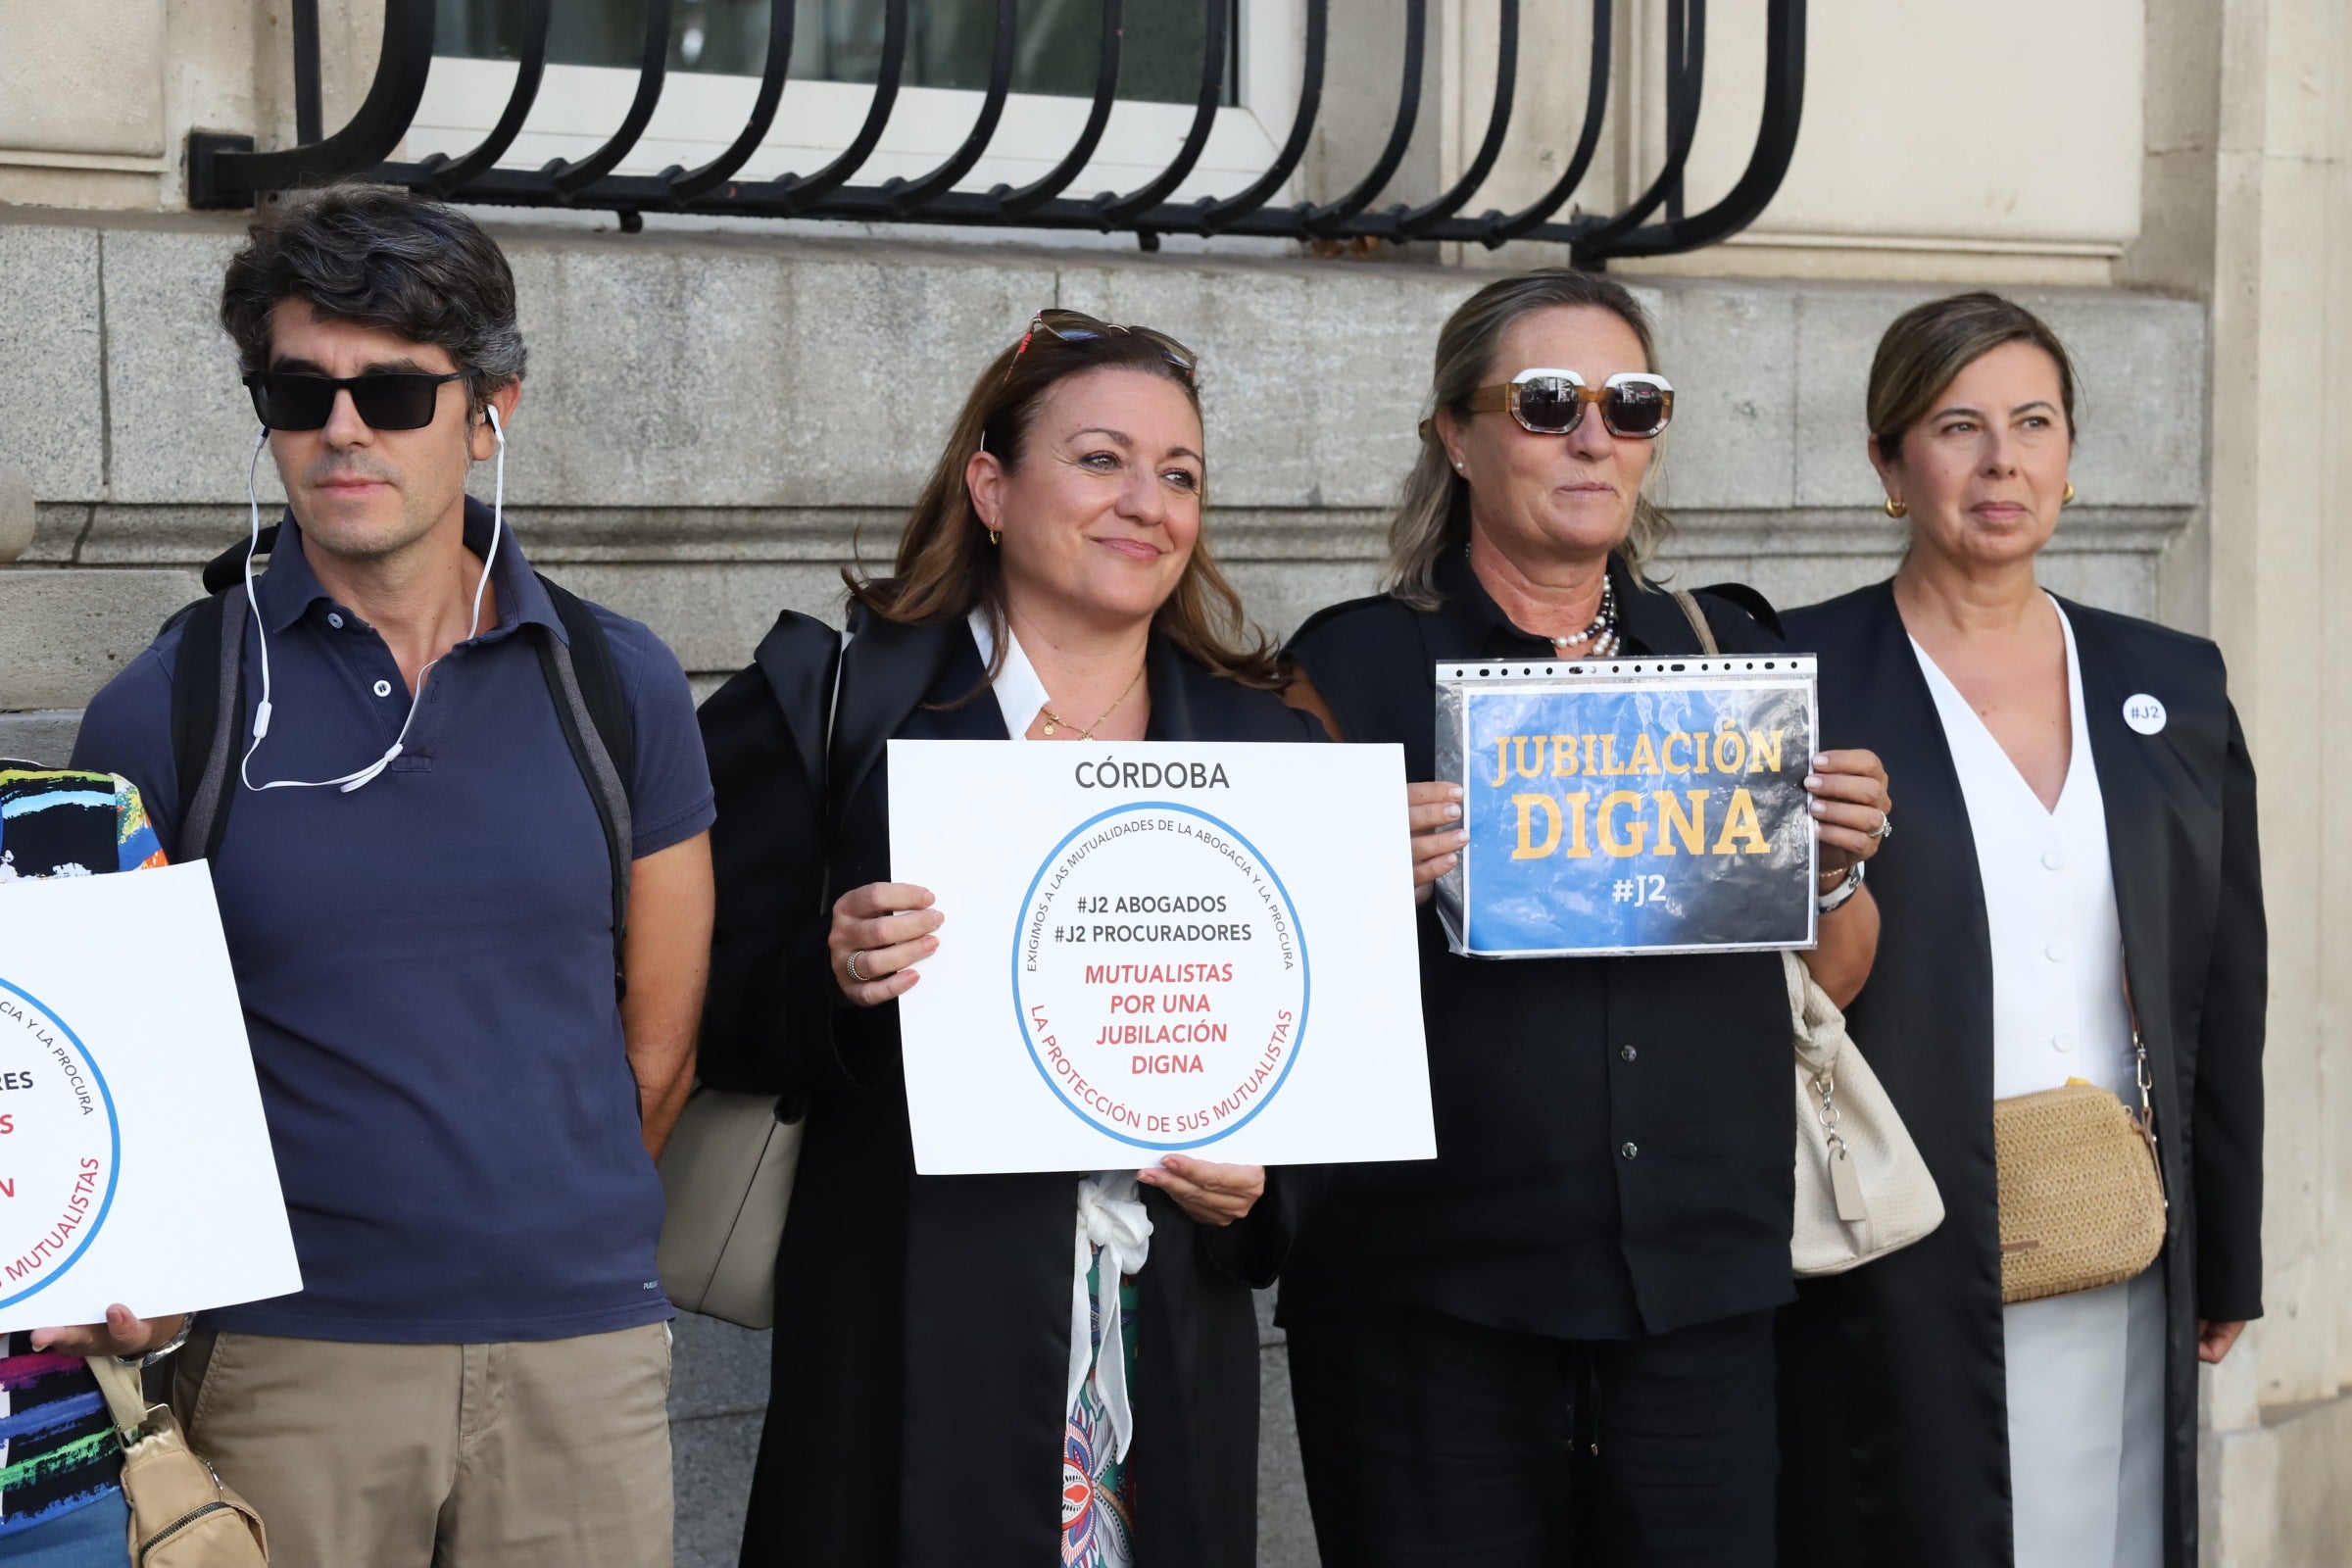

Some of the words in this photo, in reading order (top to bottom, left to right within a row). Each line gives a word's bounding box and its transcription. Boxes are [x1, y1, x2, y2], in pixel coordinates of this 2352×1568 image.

[2131, 706, 2160, 719] #J2
[1492, 718, 1785, 787] JUBILACIÓN
[1074, 755, 1231, 790] CÓRDOBA
[1511, 788, 1771, 860] DIGNA
[1026, 903, 1050, 972] EXIGIMOS
[1045, 892, 1055, 903] A
[1050, 865, 1069, 891] LAS
[1066, 818, 1154, 868] MUTUALIDADES
[1157, 819, 1174, 832] DE
[1177, 822, 1192, 837] LA
[1195, 829, 1251, 877] ABOGACIA
[1251, 873, 1261, 884] Y
[1257, 885, 1271, 904] LA
[1268, 904, 1294, 970] PROCURA
[1077, 896, 1109, 914] #J2
[1114, 895, 1227, 913] ABOGADOS
[1611, 874, 1667, 907] #J2
[1054, 925, 1087, 943] #J2
[1092, 923, 1252, 943] PROCURADORES
[1085, 962, 1233, 985] MUTUALISTAS
[1110, 994, 1155, 1014] POR
[1162, 993, 1211, 1014] UNA
[1096, 1018, 1228, 1046] JUBILACIÓN
[26, 1018, 38, 1030] Y
[35, 1028, 54, 1049] LA
[52, 1047, 94, 1116] PROCURA
[1031, 1004, 1050, 1033] LA
[1041, 1034, 1142, 1129] PROTECCIÓN
[1147, 1114, 1171, 1133] DE
[1176, 1109, 1210, 1133] SUS
[1212, 1009, 1293, 1121] MUTUALISTAS
[1131, 1054, 1204, 1075] DIGNA
[0, 1070, 34, 1091] ES
[4, 1156, 99, 1282] MUTUALISTAS
